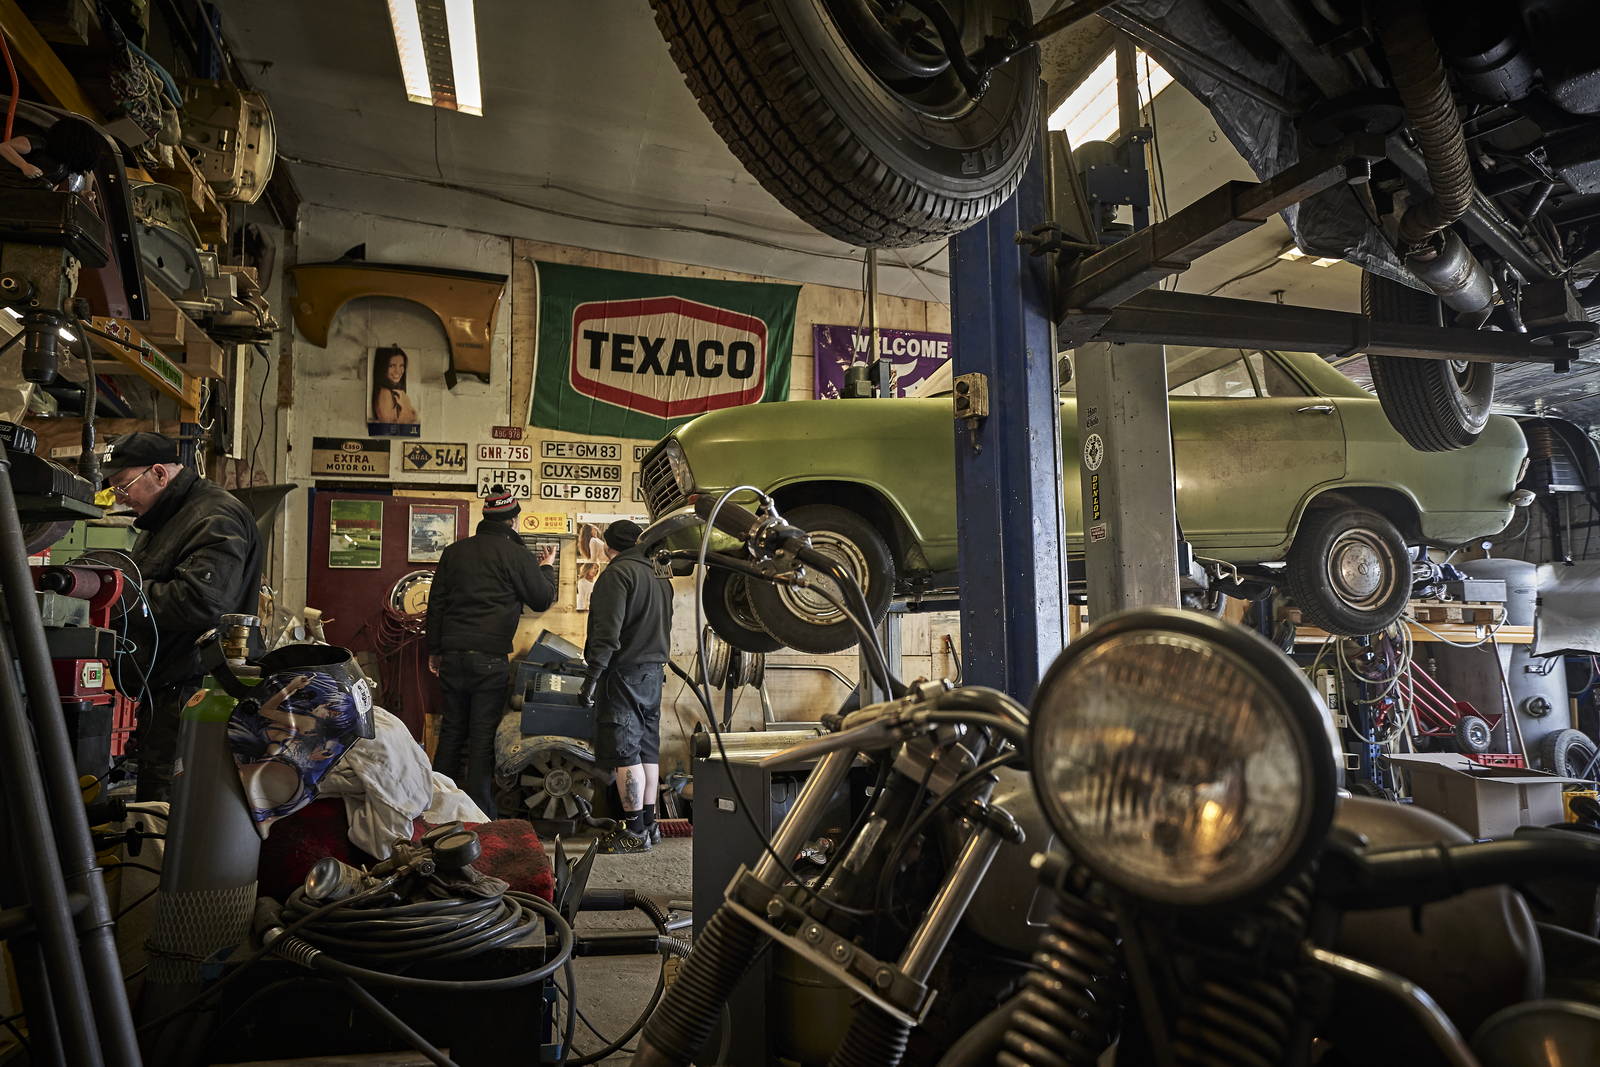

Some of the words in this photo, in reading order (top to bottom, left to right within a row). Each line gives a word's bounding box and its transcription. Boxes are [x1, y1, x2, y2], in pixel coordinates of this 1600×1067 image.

[851, 334, 949, 359] WLCOME
[583, 329, 755, 380] TEXACO
[334, 454, 369, 463] EXTRA
[435, 448, 464, 467] 544
[600, 445, 616, 458] 83
[326, 463, 358, 471] MOTOR
[361, 464, 376, 472] OIL
[603, 466, 619, 480] 69
[585, 486, 619, 500] 6887
[1092, 475, 1100, 520] DUNLOP
